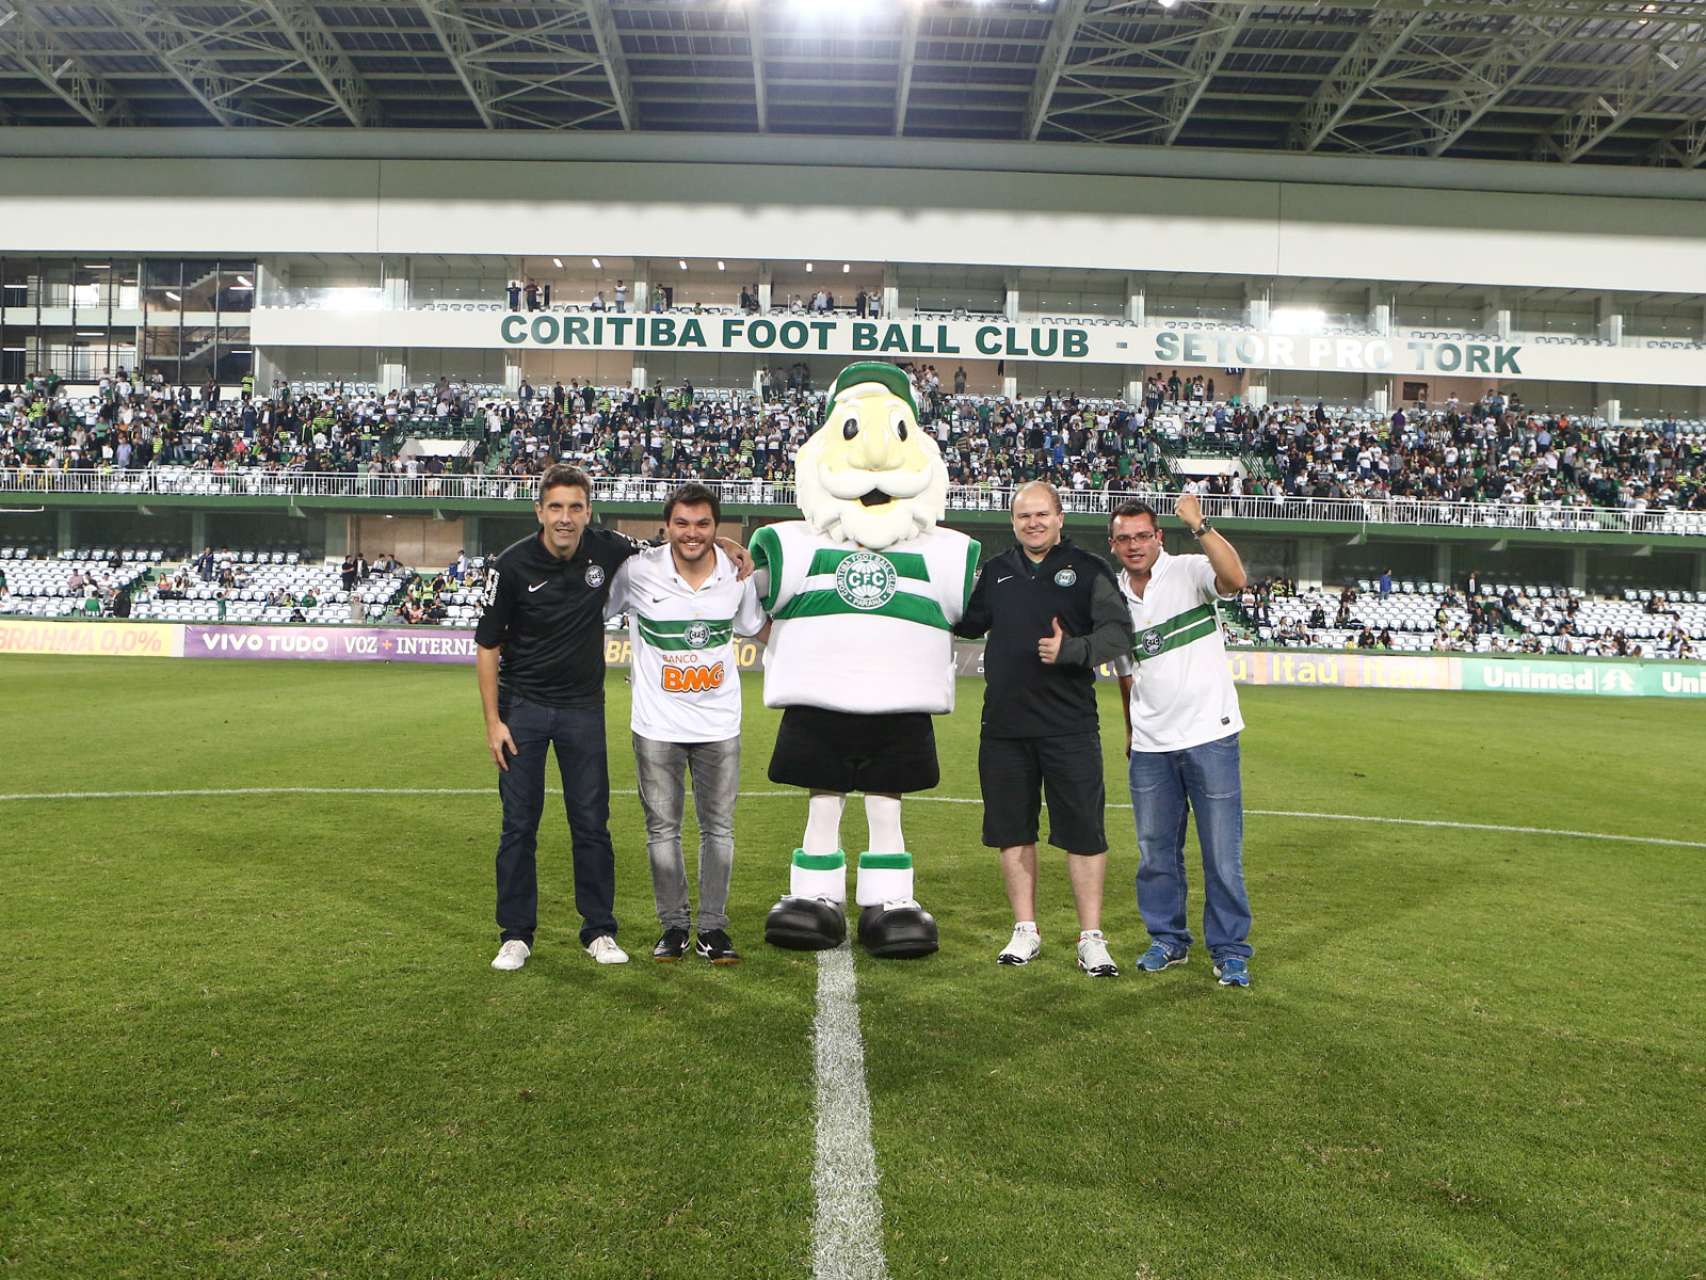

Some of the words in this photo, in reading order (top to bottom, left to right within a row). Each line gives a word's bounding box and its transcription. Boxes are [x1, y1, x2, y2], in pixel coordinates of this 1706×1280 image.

[500, 315, 707, 347] CORITIBA
[722, 319, 837, 350] FOOT
[852, 322, 960, 354] BALL
[975, 326, 1089, 358] CLUB
[1154, 332, 1294, 366] SETOR
[1308, 337, 1393, 370] PRO
[1407, 342, 1523, 374] TORK
[849, 572, 884, 587] CFC
[101, 630, 162, 654] 0,0%
[202, 632, 263, 651] VIVO
[267, 635, 329, 652] TUDO
[344, 636, 378, 654] VOZ
[396, 636, 478, 656] INTERNE
[662, 654, 698, 664] BANCO
[1272, 654, 1339, 683] Itaú
[661, 661, 725, 693] BMG
[1483, 666, 1593, 690] Unimed
[1662, 671, 1706, 693] Uni
